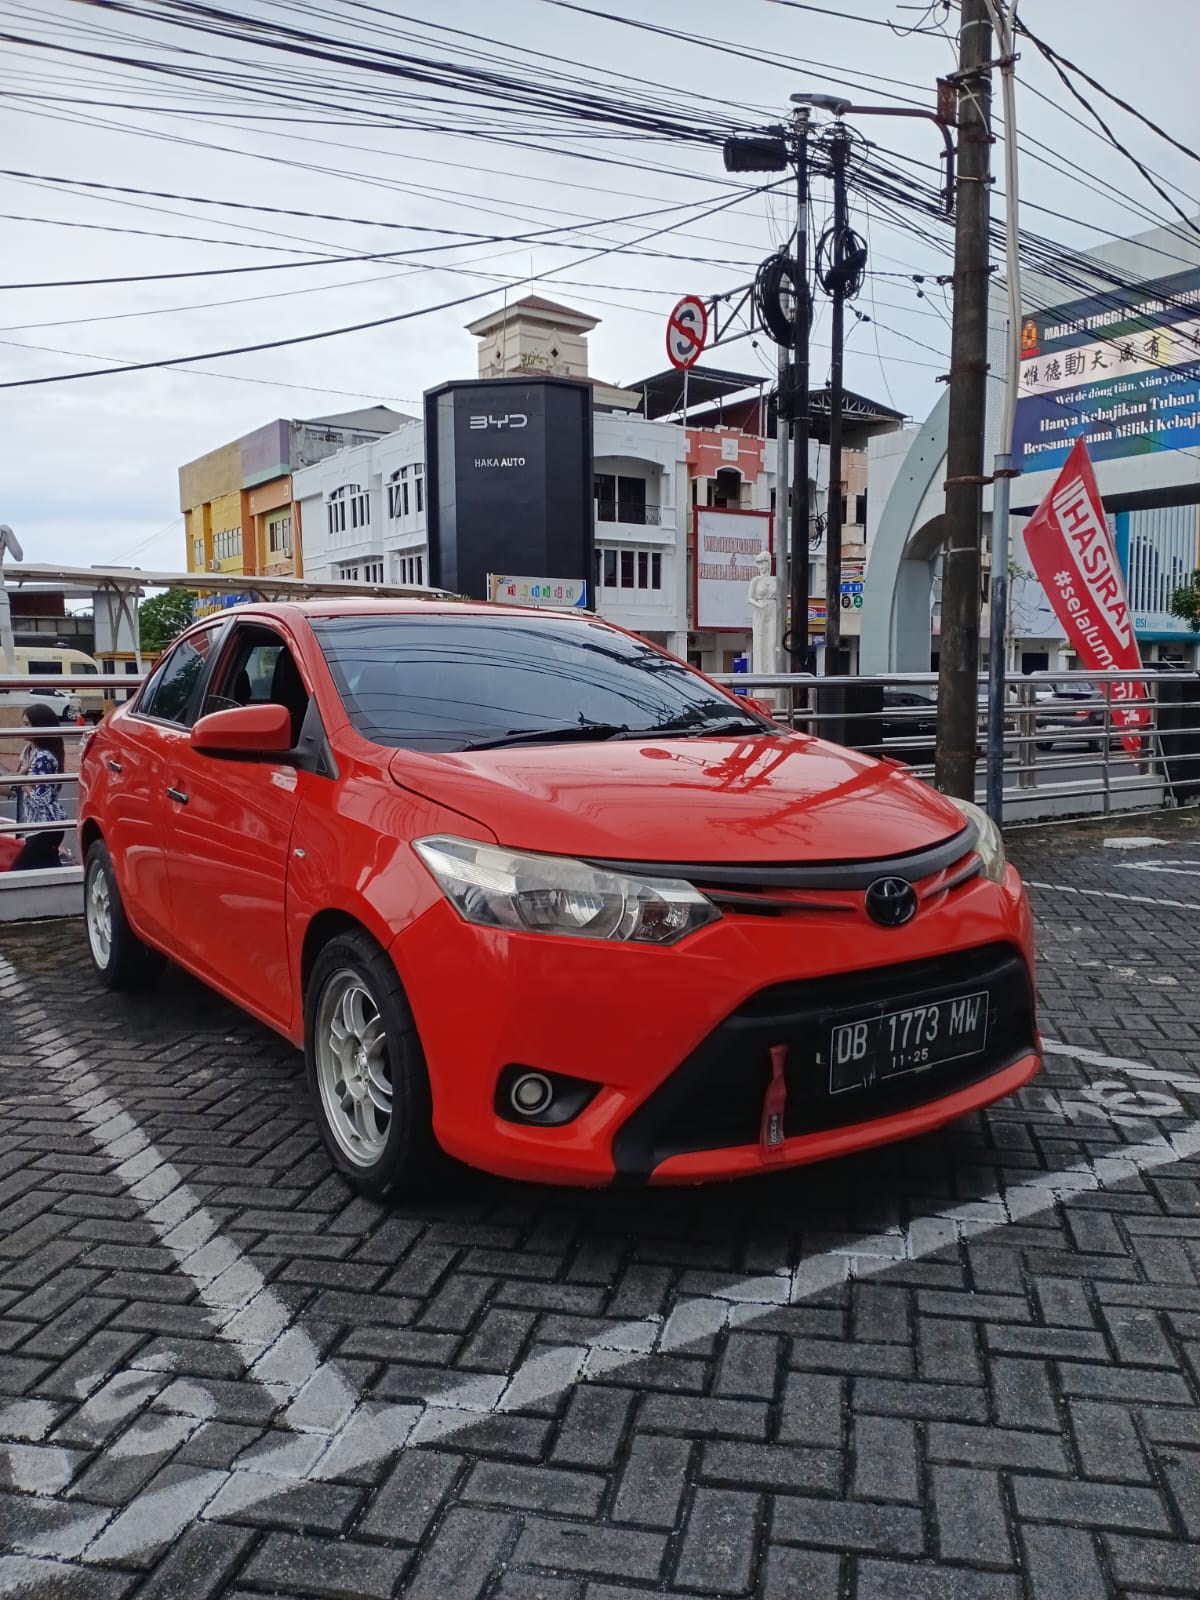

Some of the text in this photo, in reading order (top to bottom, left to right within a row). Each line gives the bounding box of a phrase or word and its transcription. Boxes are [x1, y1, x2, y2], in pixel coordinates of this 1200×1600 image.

[1086, 308, 1122, 329] TINGGI
[469, 413, 528, 429] BYD
[1040, 416, 1079, 432] Hanya
[1081, 402, 1147, 423] Kebajikan
[1149, 393, 1195, 410] Tuhan
[1023, 430, 1113, 455] Bersama-ama
[1115, 419, 1155, 439] Miliki
[474, 456, 525, 468] HAKA AUTO
[1135, 617, 1146, 628] BSI
[837, 996, 981, 1065] DB 1773 MW
